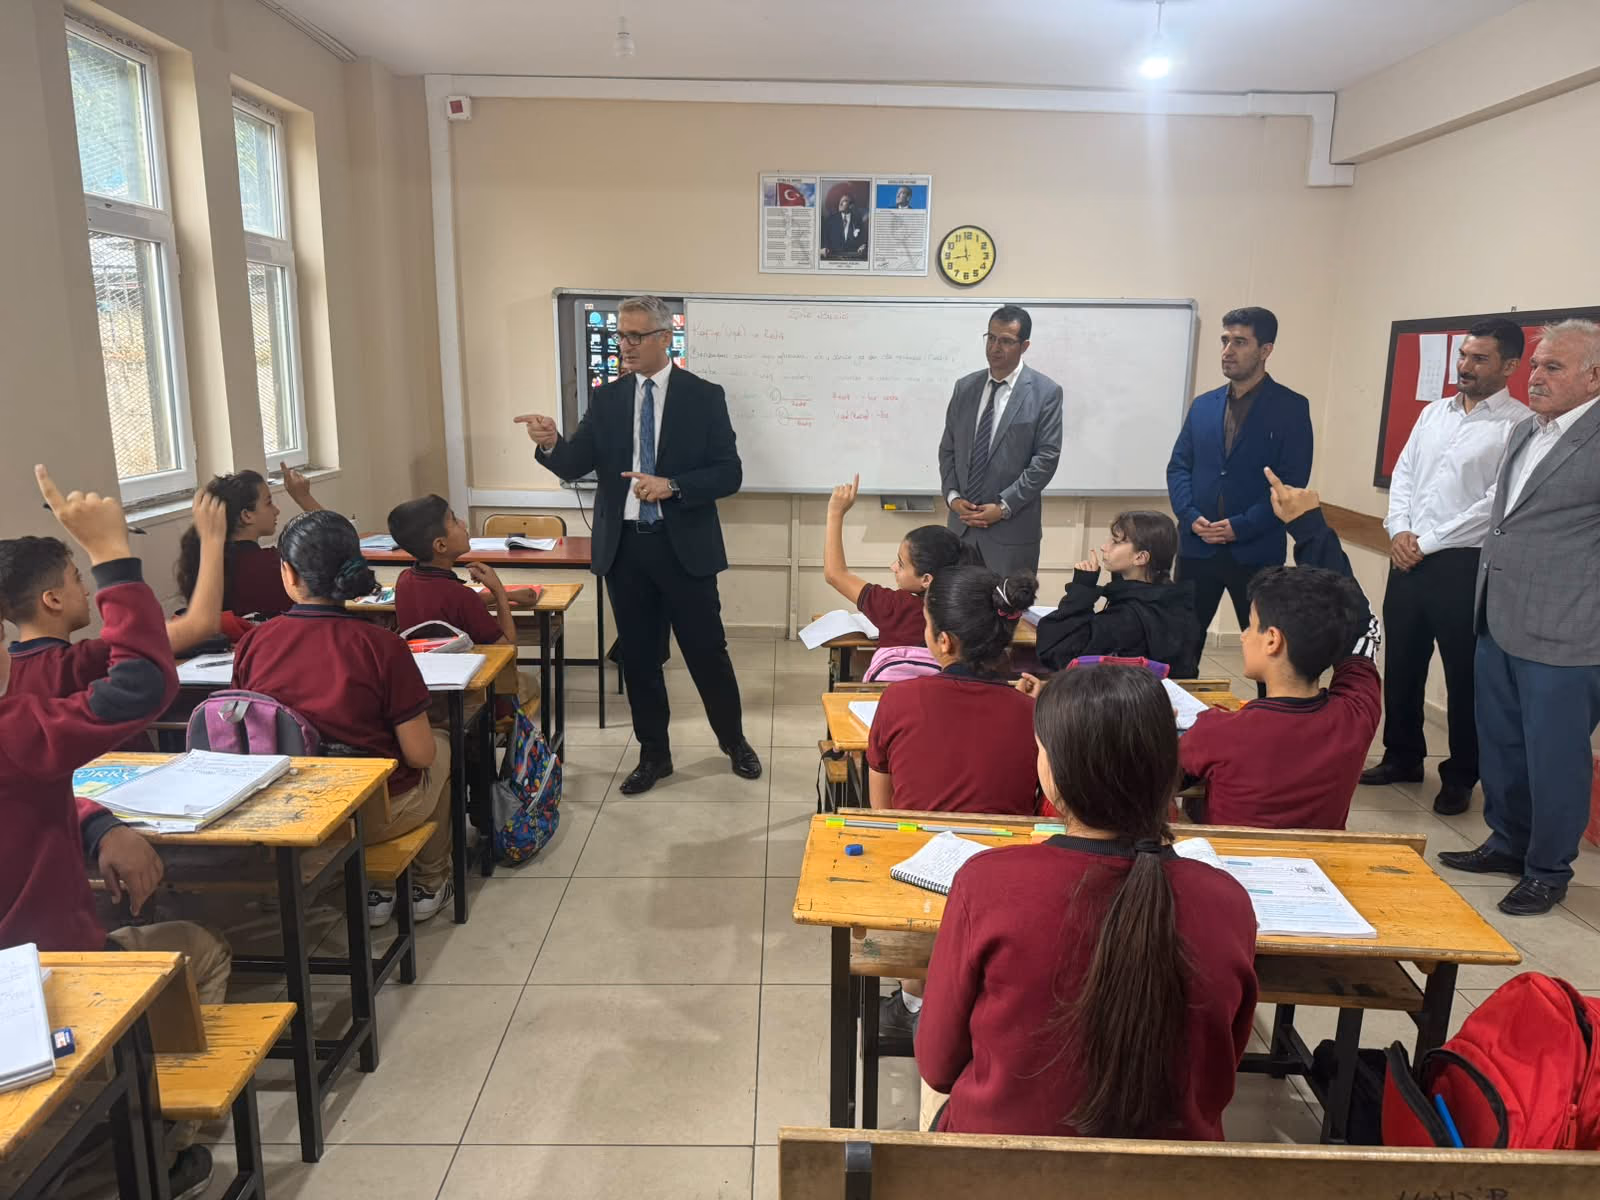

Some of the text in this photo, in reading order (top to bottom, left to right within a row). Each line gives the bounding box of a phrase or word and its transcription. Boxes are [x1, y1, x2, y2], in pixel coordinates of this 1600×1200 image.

[956, 234, 961, 242] 11
[964, 232, 972, 240] 12
[948, 242, 954, 250] 10
